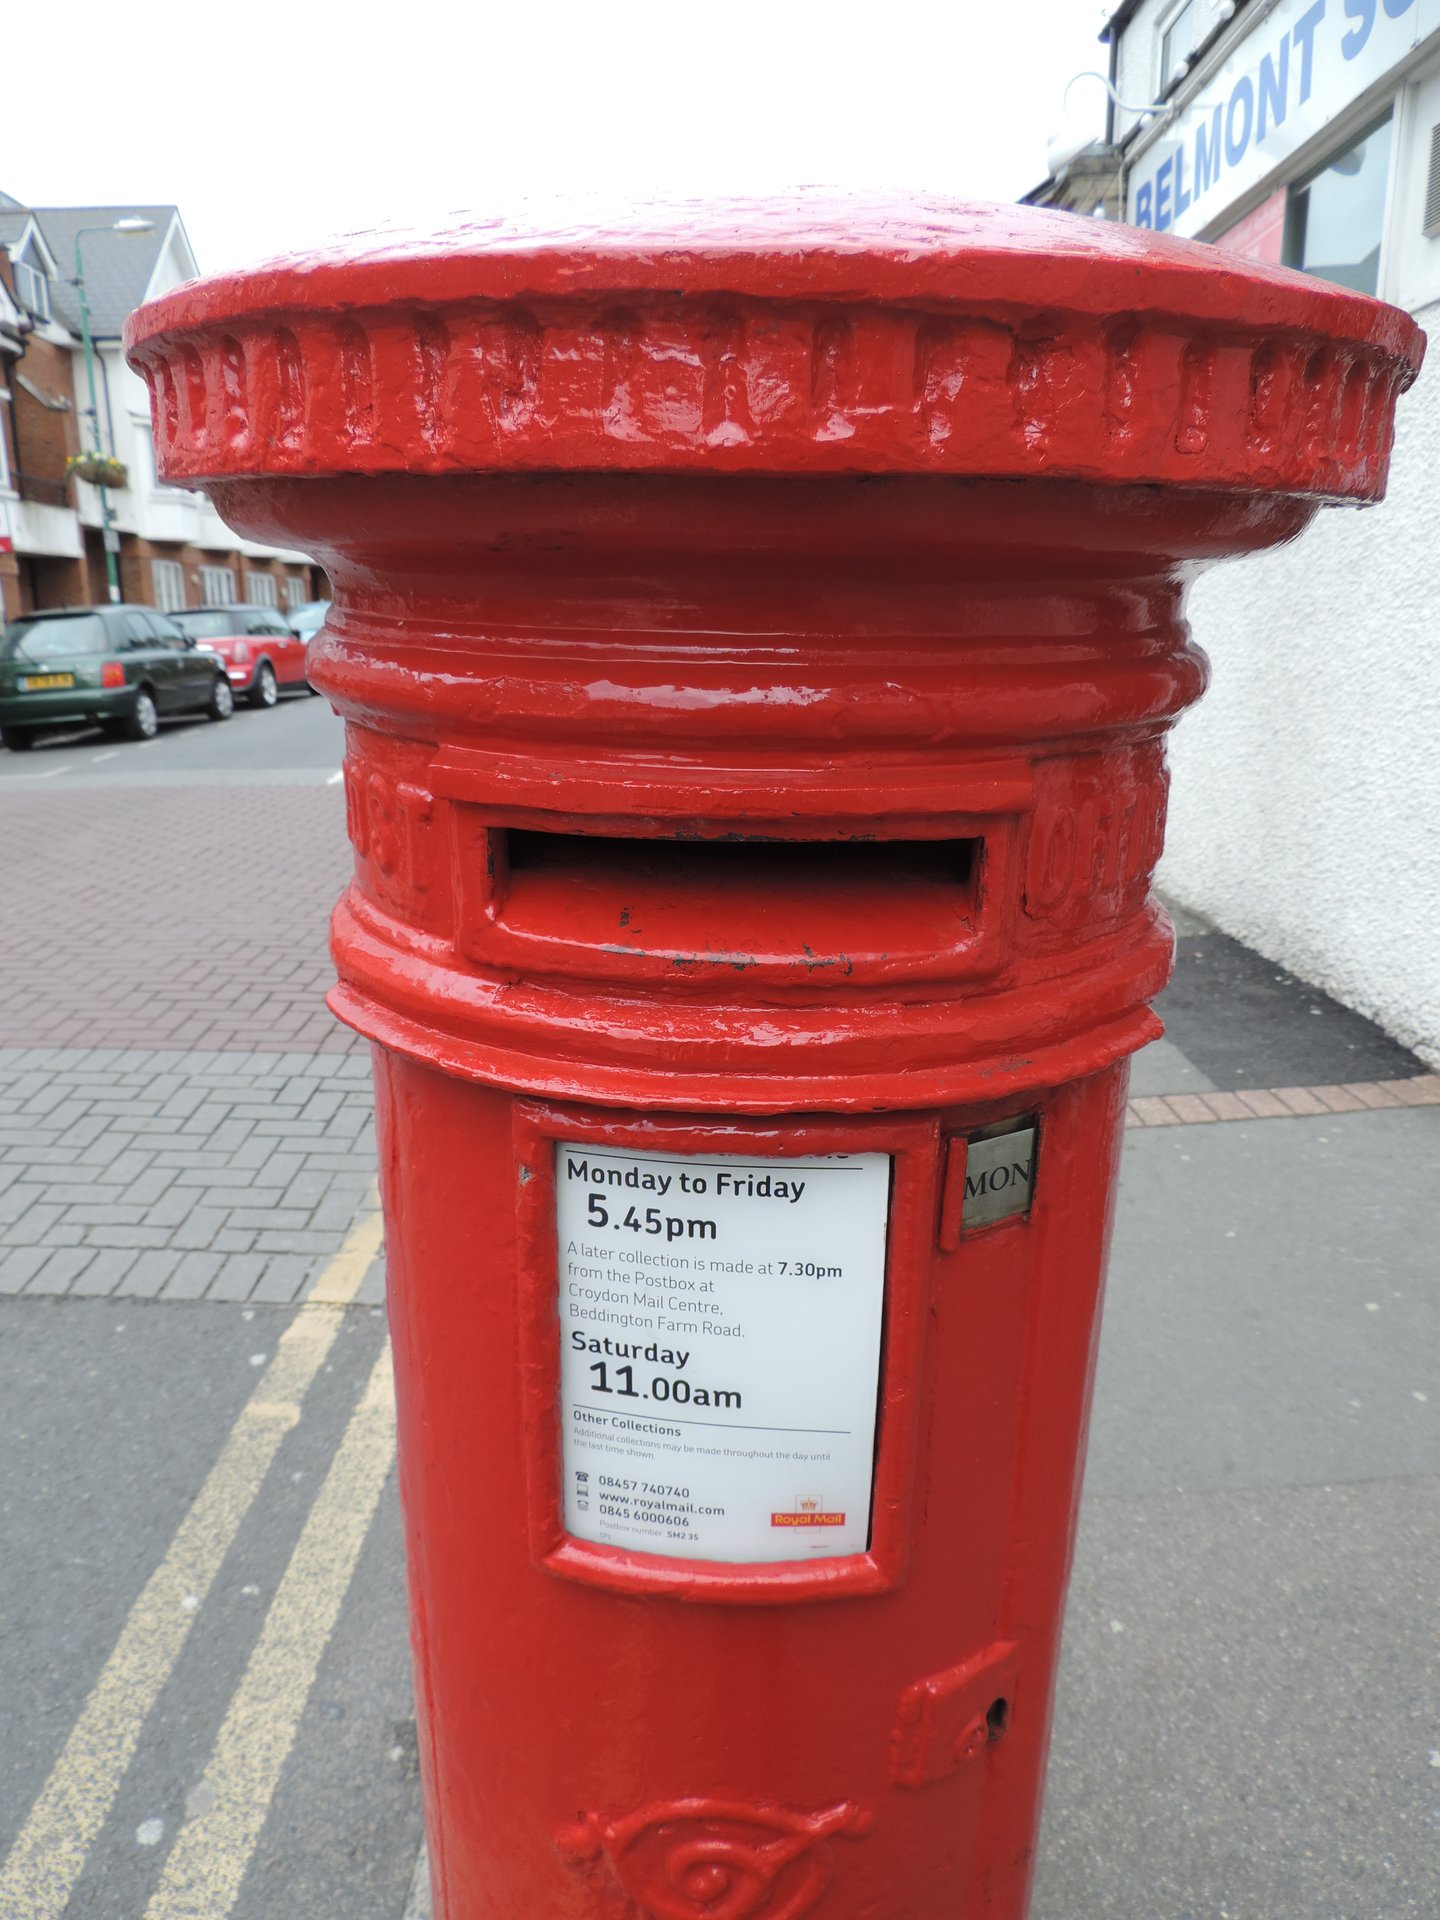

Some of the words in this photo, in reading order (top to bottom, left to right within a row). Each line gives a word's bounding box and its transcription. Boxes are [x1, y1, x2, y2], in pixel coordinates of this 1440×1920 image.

[1135, 0, 1325, 232] BELMONT
[567, 1158, 672, 1196] Monday
[679, 1172, 707, 1194] to
[716, 1173, 806, 1203] Friday
[963, 1159, 1032, 1200] MON
[587, 1193, 717, 1242] 5.45pm
[567, 1241, 578, 1255] A
[581, 1243, 614, 1261] later
[618, 1249, 689, 1270] collection
[694, 1256, 705, 1271] is
[710, 1258, 753, 1275] made
[758, 1262, 773, 1276] at
[778, 1261, 843, 1279] 7.30pm
[567, 1263, 603, 1280] from
[606, 1267, 631, 1284] the
[635, 1272, 696, 1291] Postbox
[699, 1280, 715, 1293] at
[569, 1283, 629, 1305] Croydon
[633, 1292, 664, 1309] Mail
[569, 1303, 653, 1329] Beddington
[657, 1316, 698, 1334] Farm
[703, 1321, 745, 1339] Road.
[571, 1330, 690, 1370] Saturday
[590, 1361, 742, 1409] 11.00am
[573, 1410, 608, 1426] Other
[611, 1417, 681, 1437] Collections
[573, 1427, 614, 1441] Additional
[616, 1435, 661, 1449] collections
[662, 1442, 682, 1453] may
[683, 1445, 694, 1453] be
[696, 1446, 721, 1456] made
[723, 1448, 774, 1459] throughout
[775, 1451, 791, 1460] the
[792, 1452, 808, 1462] day
[810, 1453, 831, 1461] until
[573, 1439, 587, 1448] the
[588, 1441, 603, 1451] last
[605, 1442, 625, 1454] time
[598, 1475, 638, 1491] 08457
[641, 1482, 690, 1498] 740740
[599, 1491, 725, 1516] www.royalmail.com
[599, 1504, 630, 1519] 0845
[633, 1510, 690, 1527] 6000606
[600, 1519, 630, 1532] Postbox
[631, 1526, 662, 1537] number
[775, 1514, 811, 1526] Royal
[814, 1514, 842, 1524] Mail
